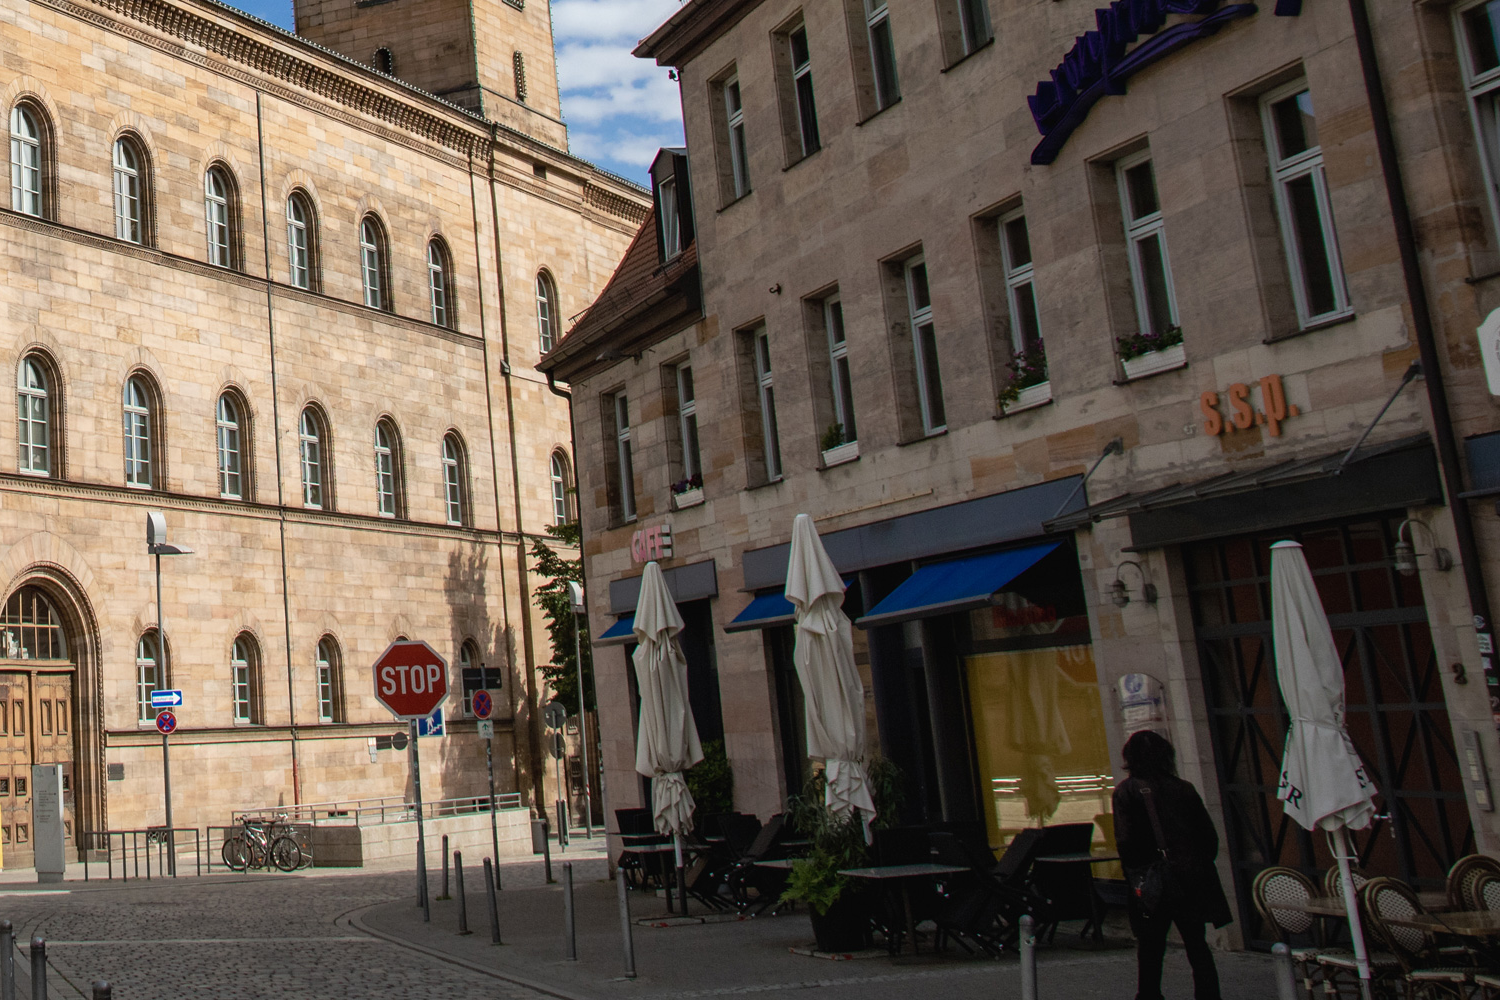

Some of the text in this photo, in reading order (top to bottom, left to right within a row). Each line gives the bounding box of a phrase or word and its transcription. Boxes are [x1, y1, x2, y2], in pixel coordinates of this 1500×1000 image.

[631, 525, 672, 562] CAFE
[381, 664, 441, 696] STOP
[1452, 662, 1468, 686] 2
